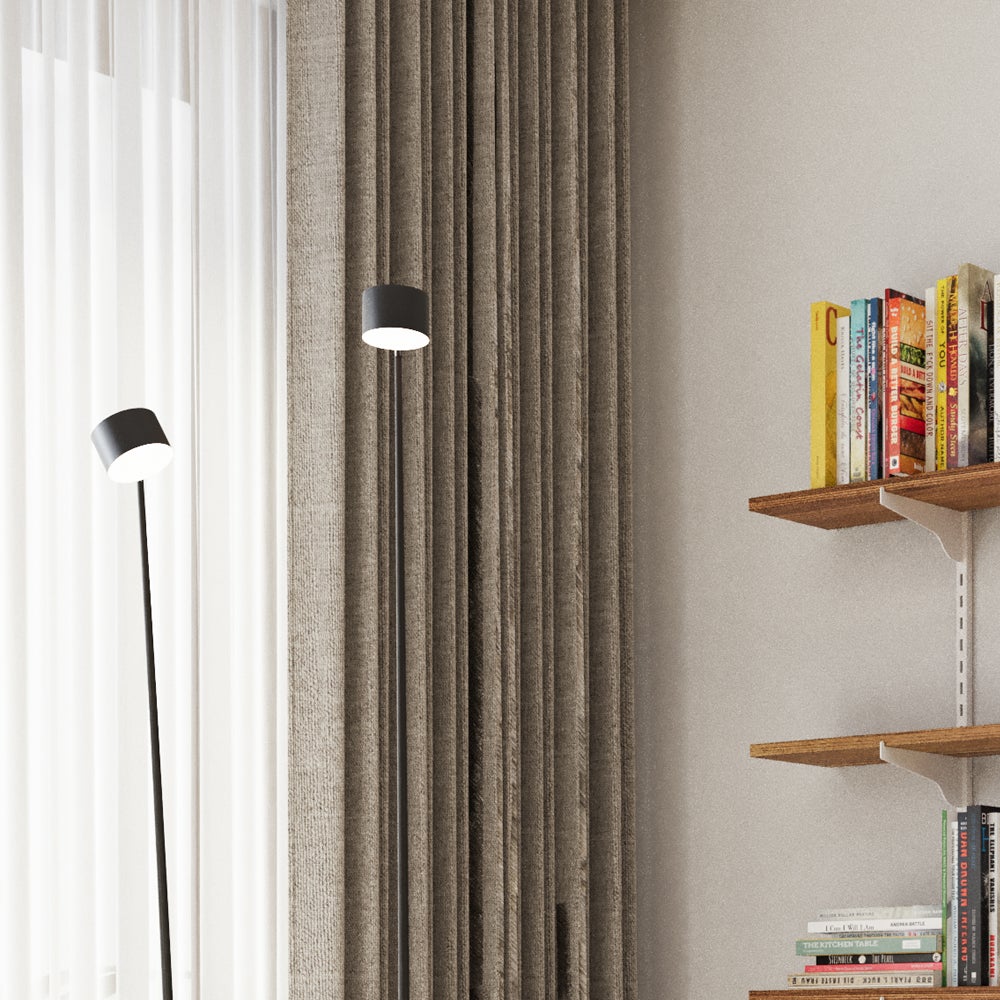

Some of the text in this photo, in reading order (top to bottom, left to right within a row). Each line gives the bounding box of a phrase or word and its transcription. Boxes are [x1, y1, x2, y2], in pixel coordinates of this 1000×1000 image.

[856, 328, 865, 440] The Gelatin Coast
[889, 326, 899, 445] BUILD A BETTER BURGER
[926, 320, 934, 438] SIT THE DOWN AND COLOR
[959, 353, 968, 387] DAYS
[949, 403, 958, 458] Sandy Steen
[802, 942, 820, 950] THE
[819, 941, 854, 949] KITCHEN
